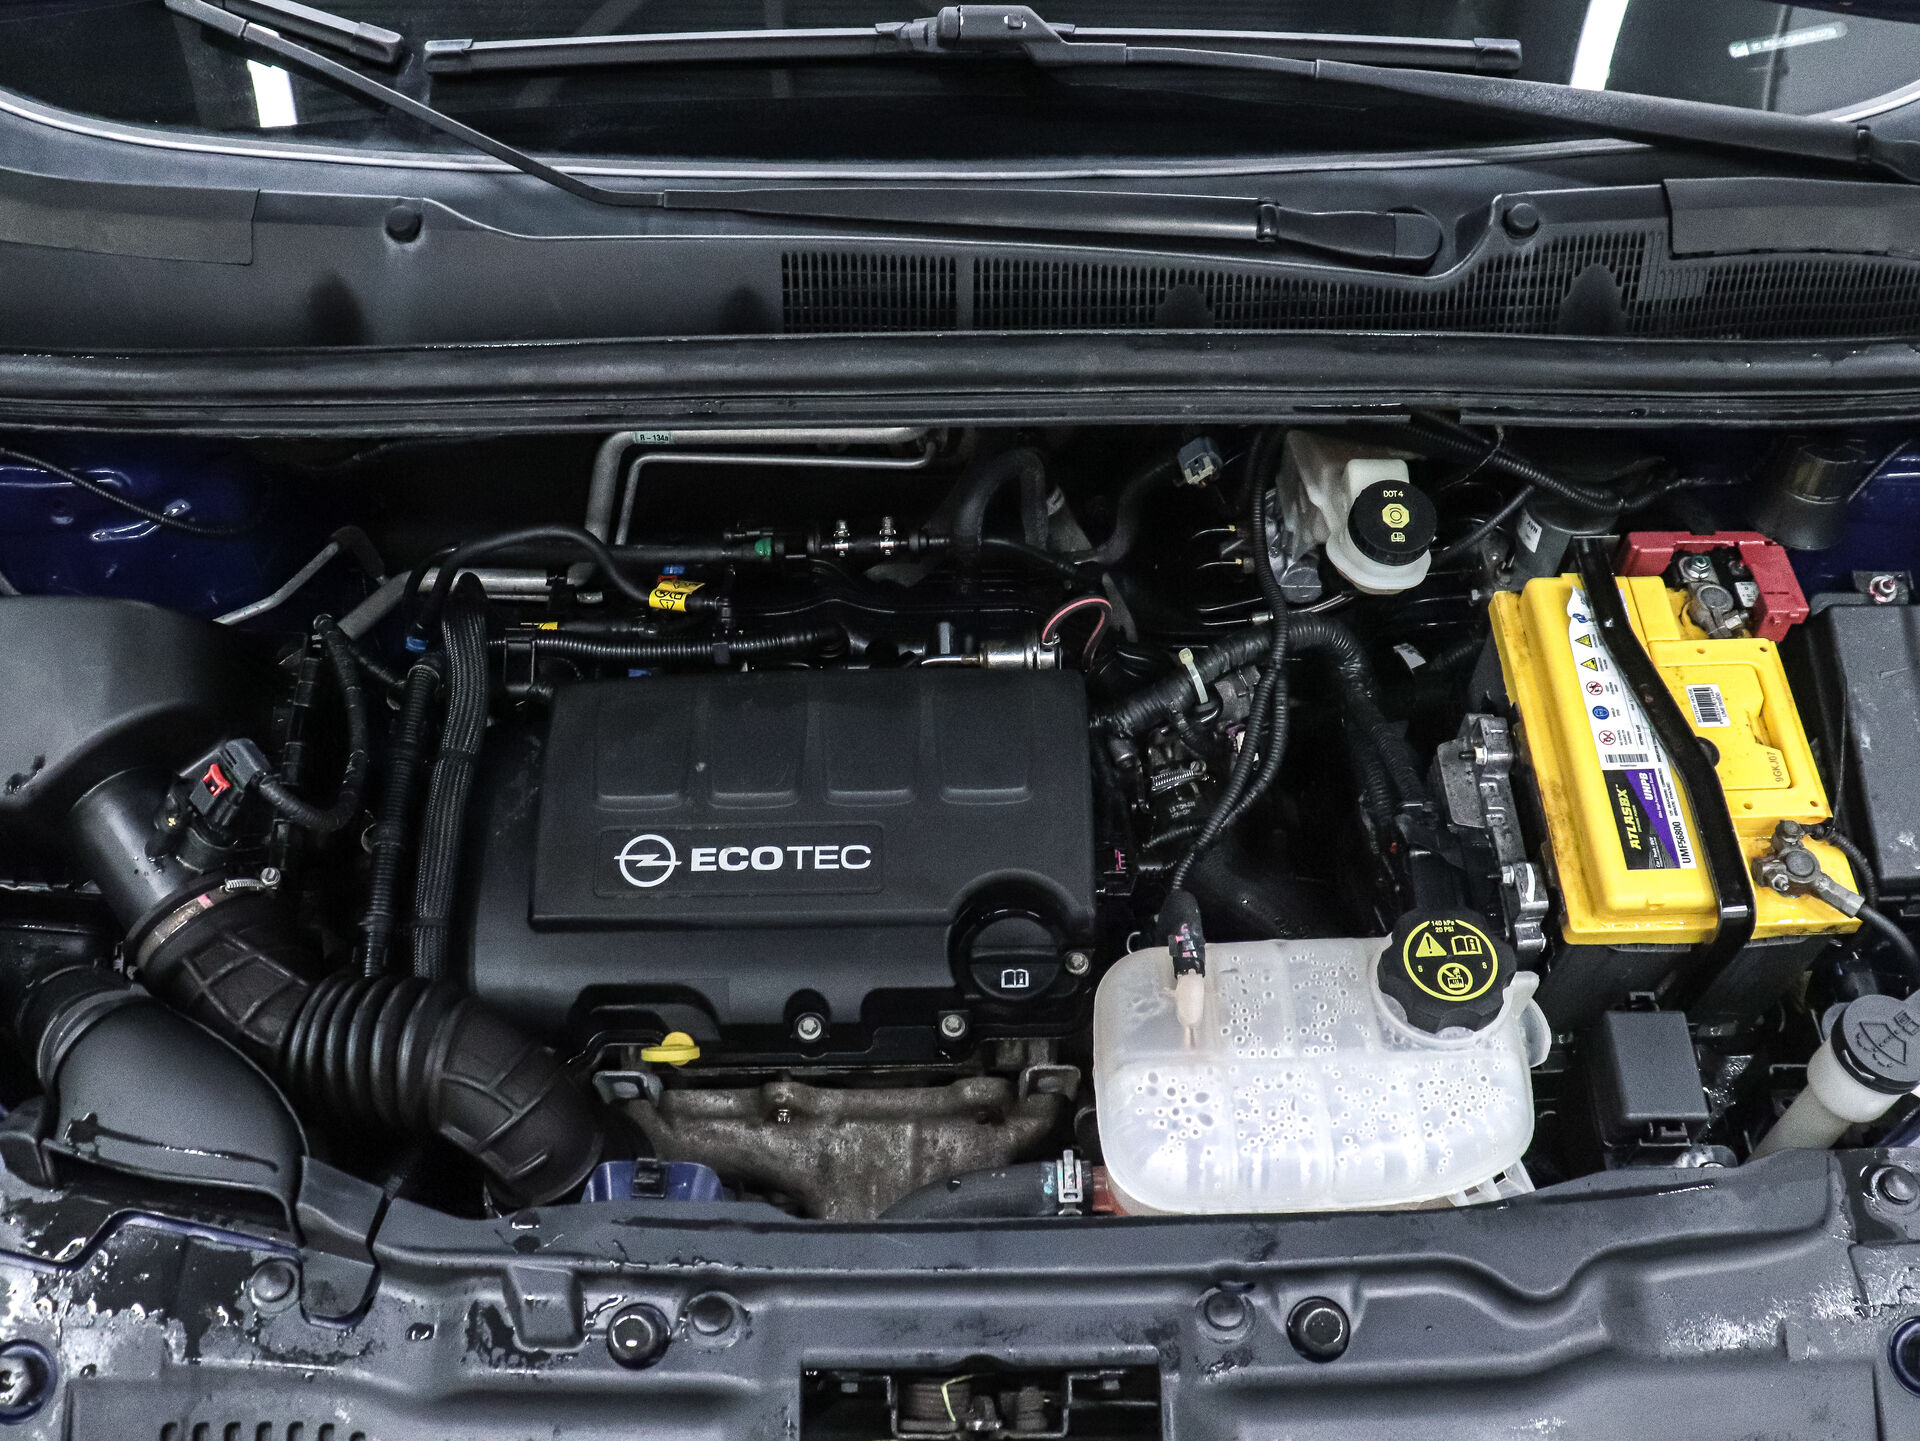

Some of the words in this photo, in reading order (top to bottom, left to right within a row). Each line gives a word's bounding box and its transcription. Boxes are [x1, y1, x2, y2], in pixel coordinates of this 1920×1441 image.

[1383, 490, 1398, 498] DOT
[1398, 490, 1404, 498] 4
[1639, 772, 1653, 801] UHPB
[1617, 789, 1641, 850] ATLASBX
[1672, 821, 1691, 864] UMF56800
[690, 844, 872, 872] ECOTEC
